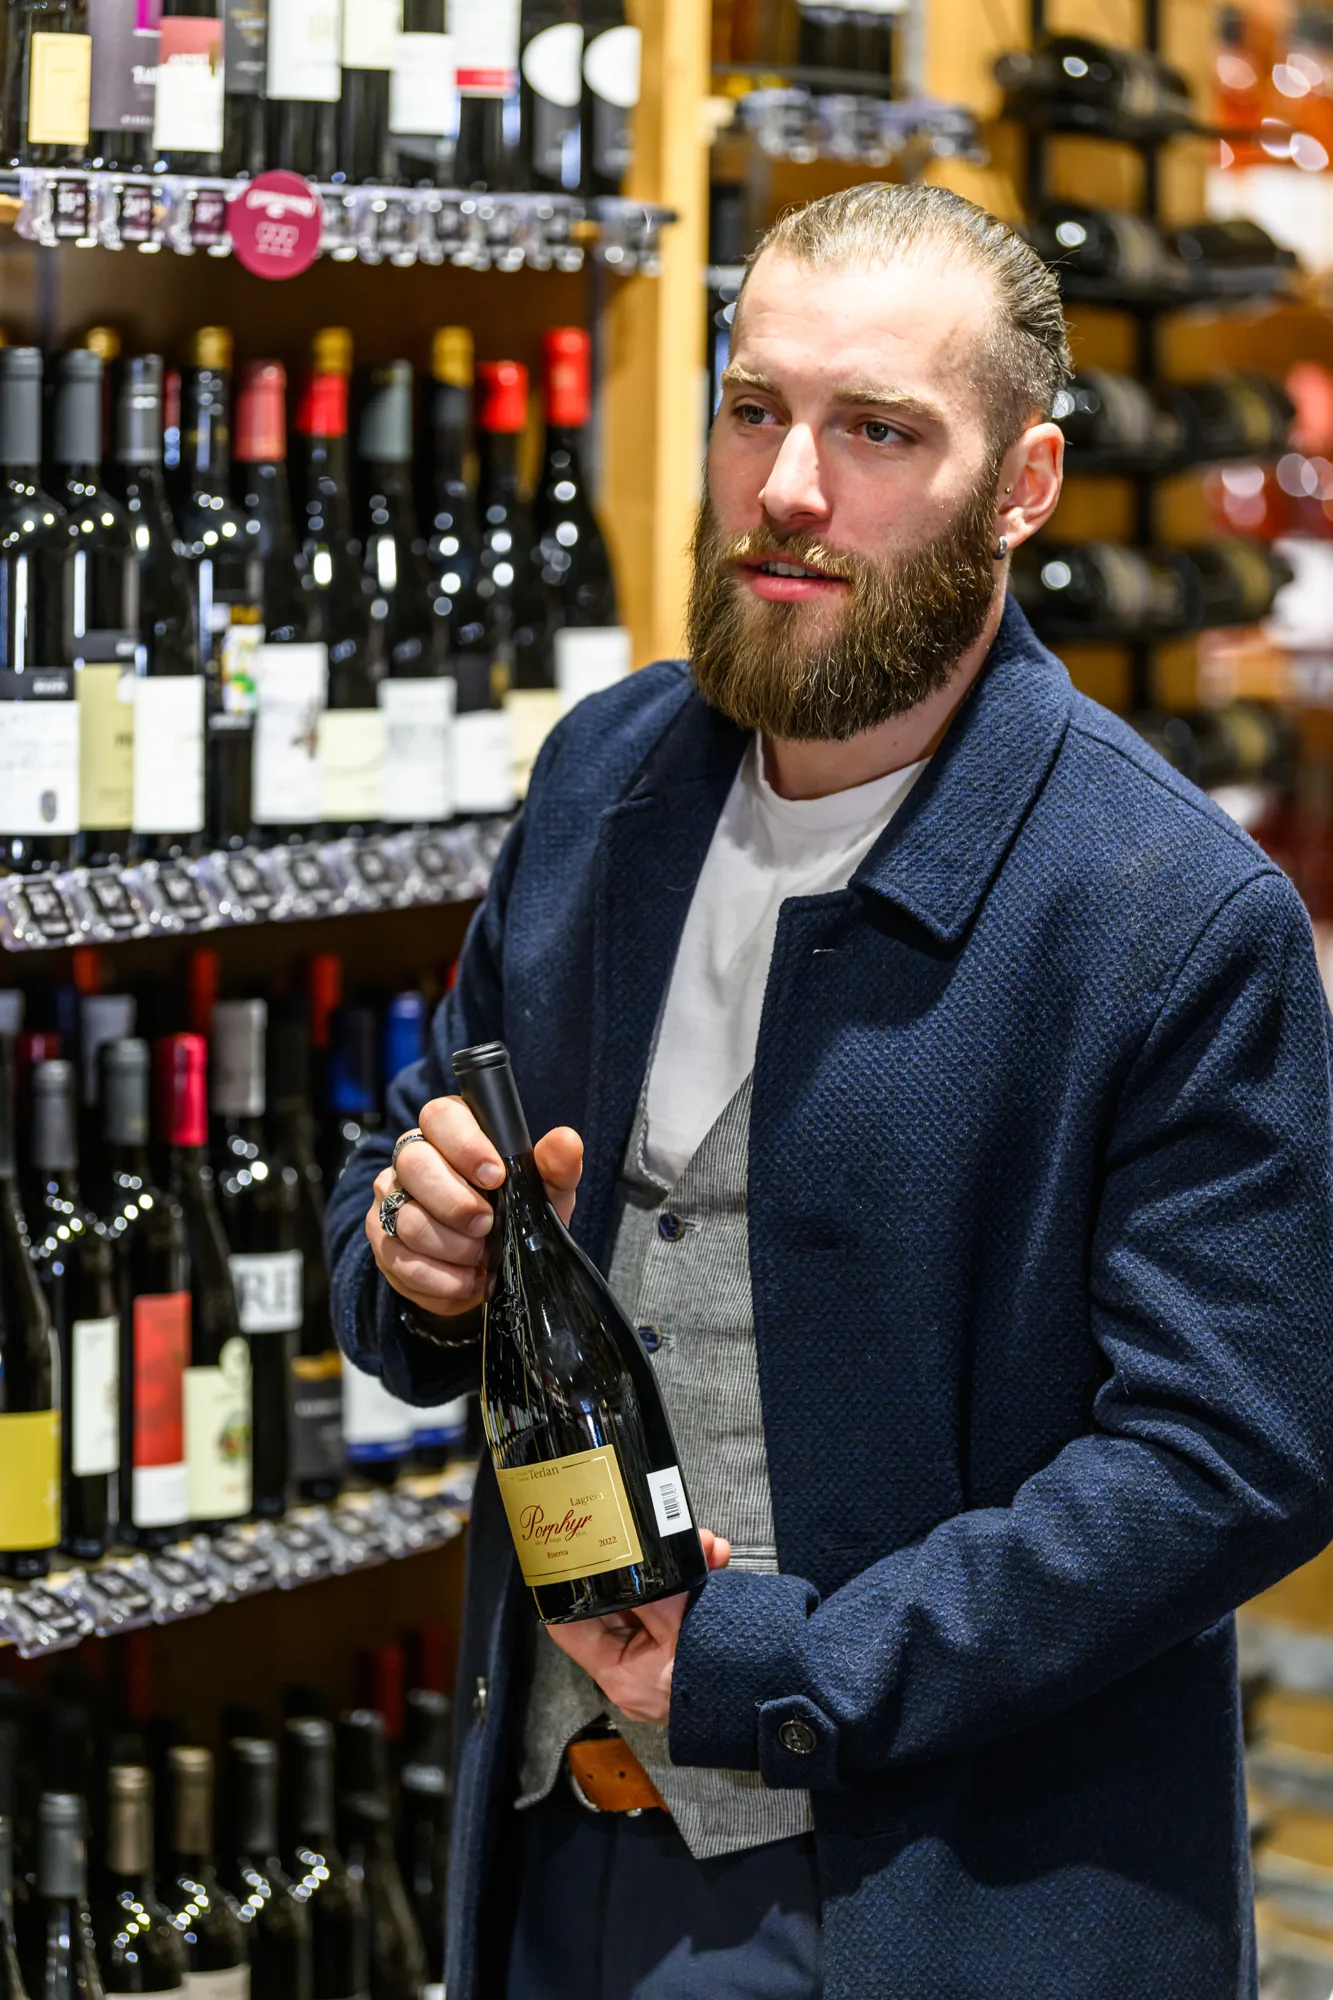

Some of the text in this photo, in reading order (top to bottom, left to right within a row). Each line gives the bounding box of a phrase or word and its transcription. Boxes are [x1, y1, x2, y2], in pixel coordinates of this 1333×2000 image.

[529, 1466, 559, 1480] Terlan
[520, 1505, 593, 1545] Porphyr
[598, 1536, 618, 1548] 2022
[546, 1549, 569, 1559] Riserva
